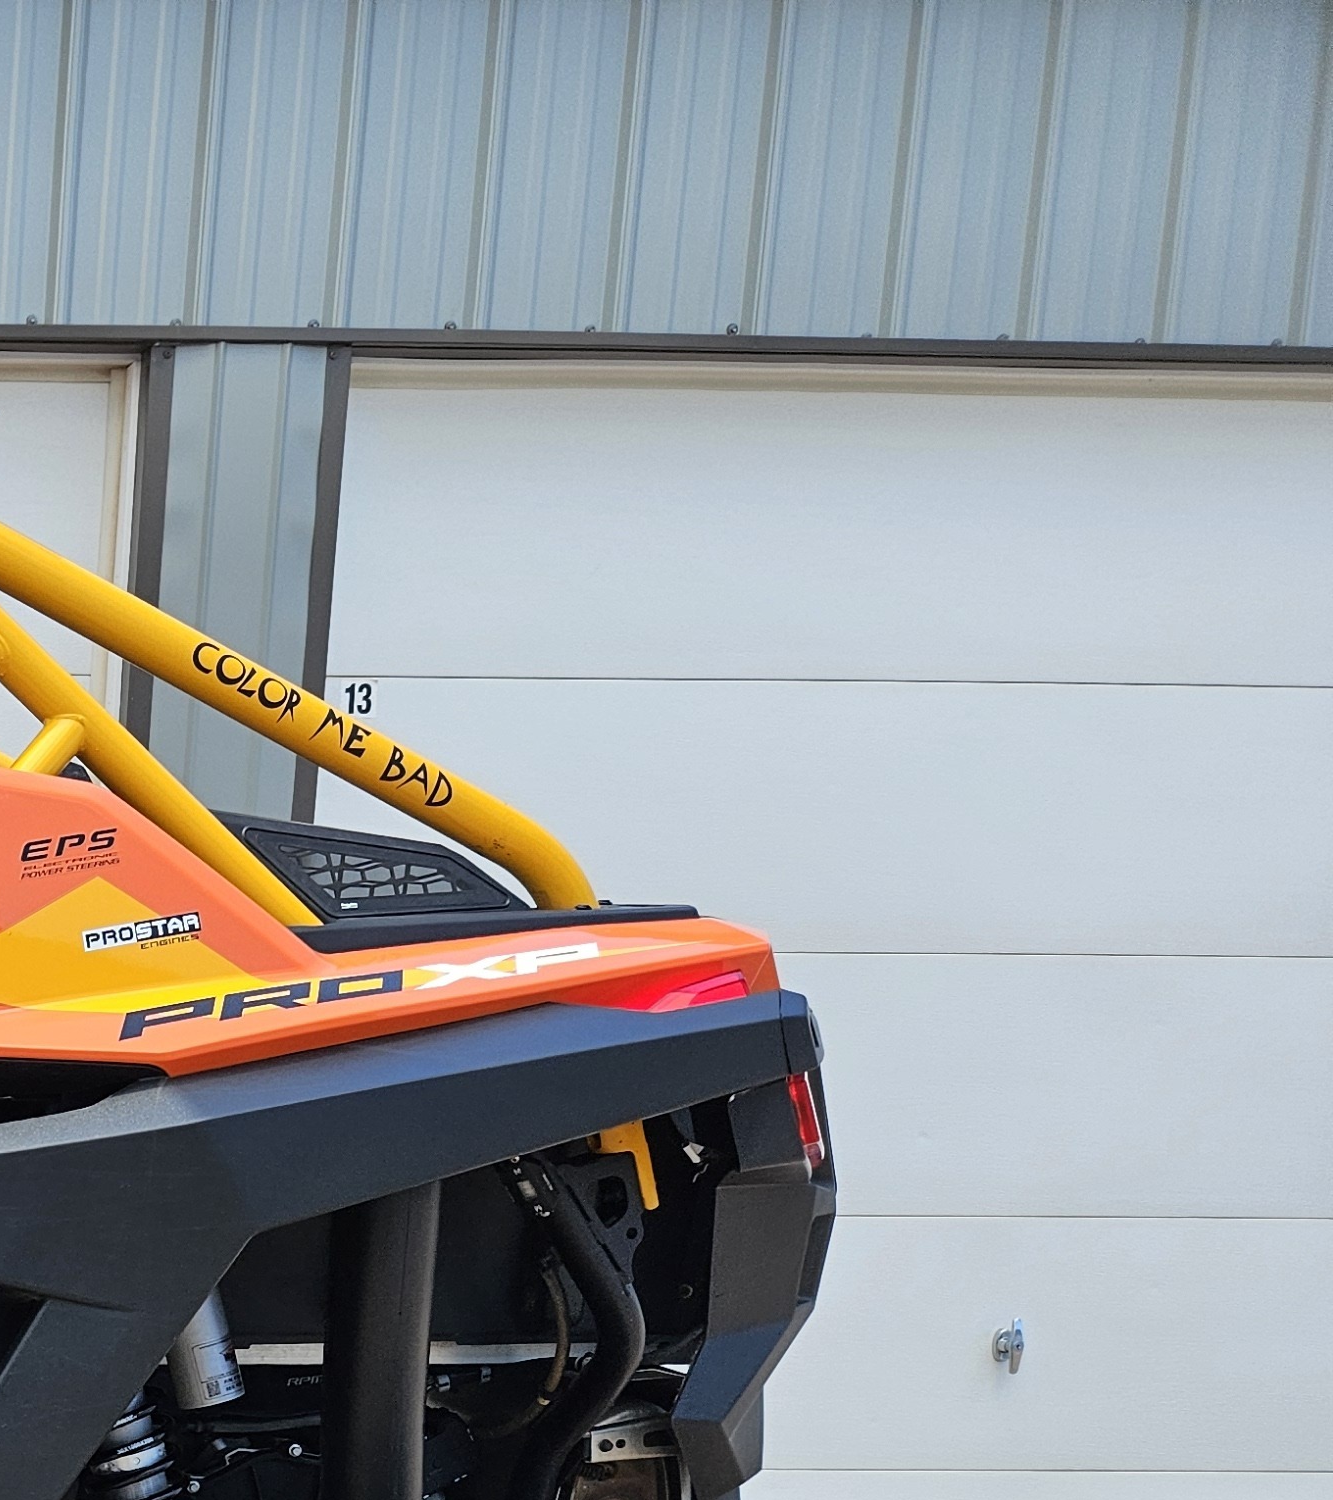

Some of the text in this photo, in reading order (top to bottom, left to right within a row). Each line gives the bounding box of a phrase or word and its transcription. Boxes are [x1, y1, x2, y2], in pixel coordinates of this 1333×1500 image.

[345, 683, 372, 714] 13
[192, 642, 453, 807] COLOR ME BAD
[21, 828, 118, 862] EPS
[21, 858, 120, 880] POWER STEERING
[23, 852, 118, 871] ELECTRONIC
[85, 914, 200, 949] PROSTAR
[141, 934, 200, 949] ENGINES
[118, 942, 599, 1041] PRO XP
